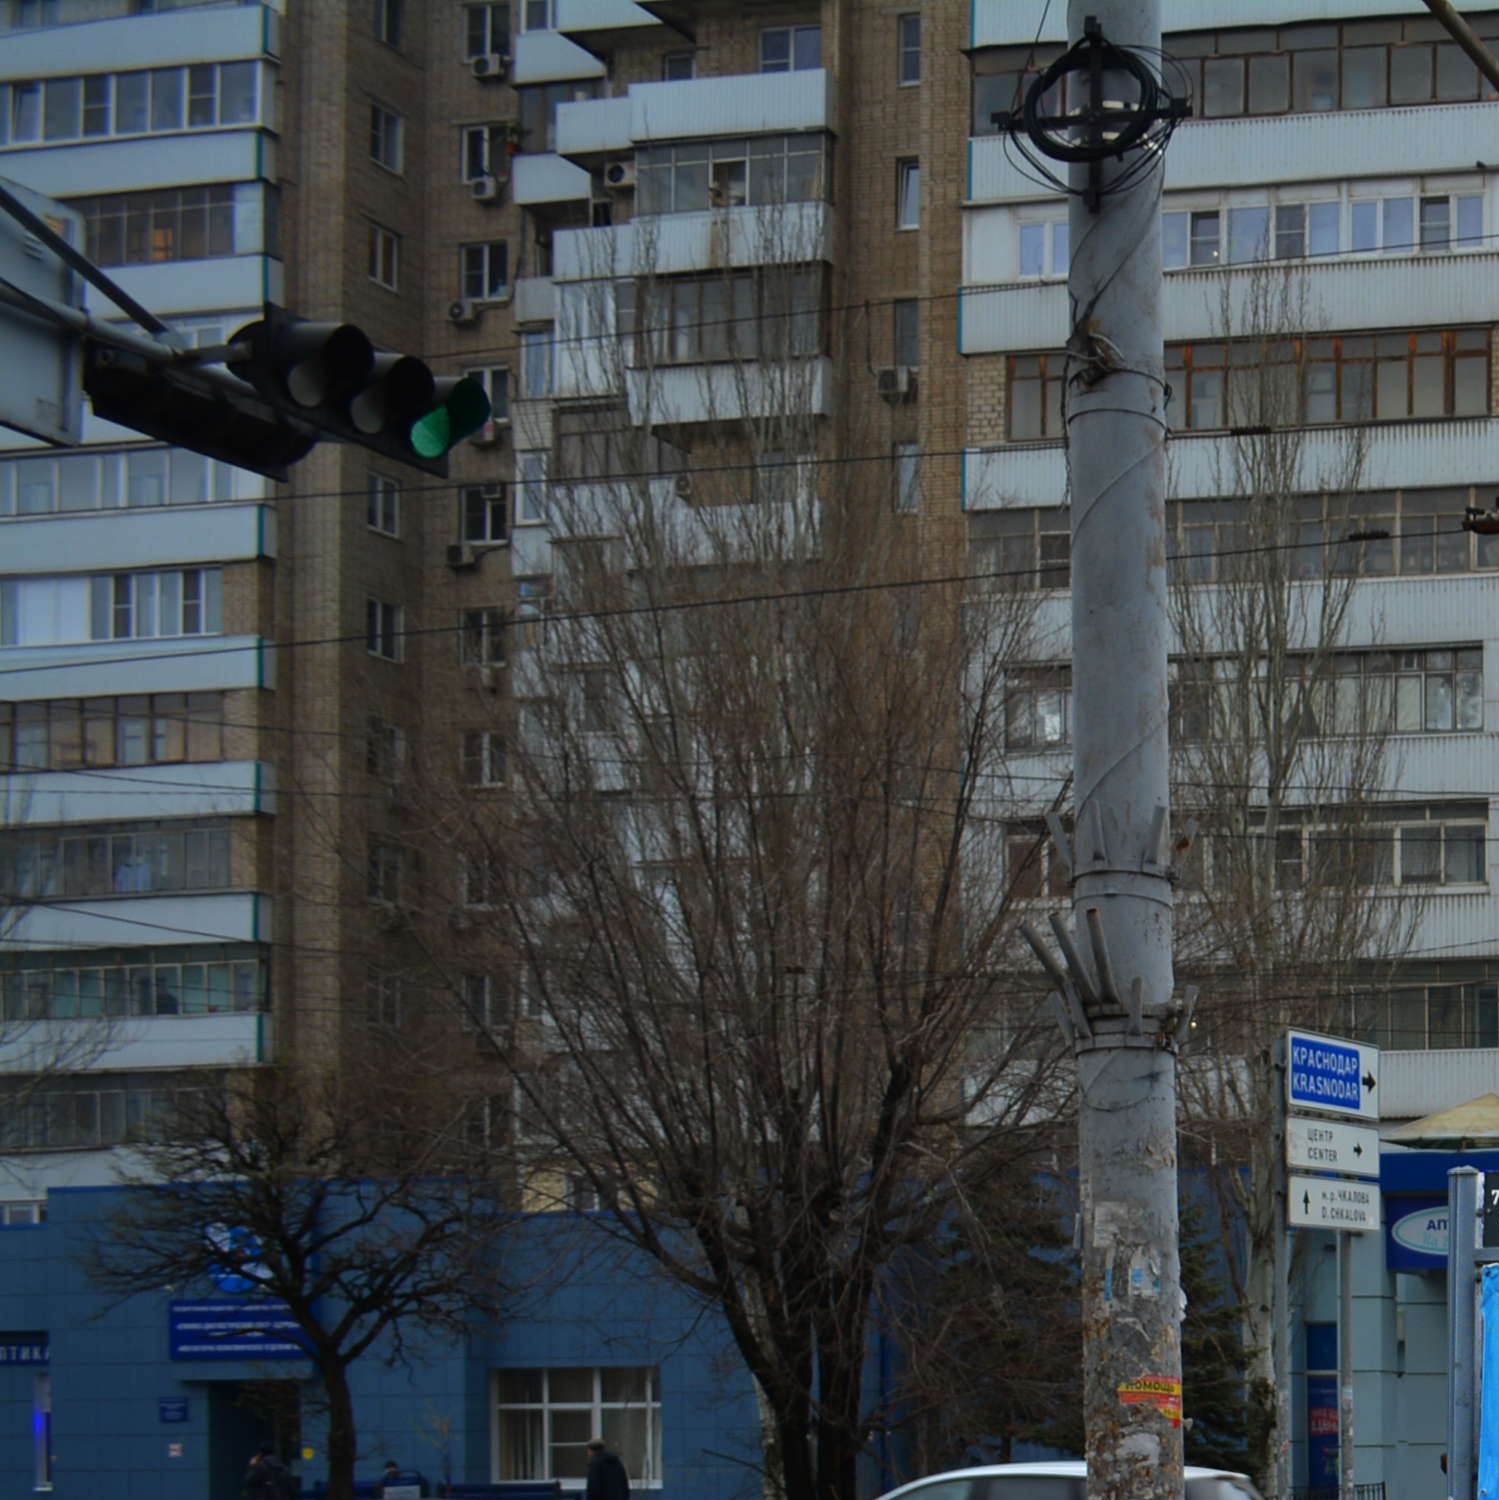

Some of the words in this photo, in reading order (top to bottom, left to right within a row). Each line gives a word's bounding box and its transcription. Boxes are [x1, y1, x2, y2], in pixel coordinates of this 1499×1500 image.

[1292, 1046, 1358, 1077] КРАСНОДАР
[1292, 1071, 1359, 1102] KRASNODAR
[1307, 1128, 1334, 1143] ЦЕНТР
[1307, 1147, 1338, 1163] CENTER
